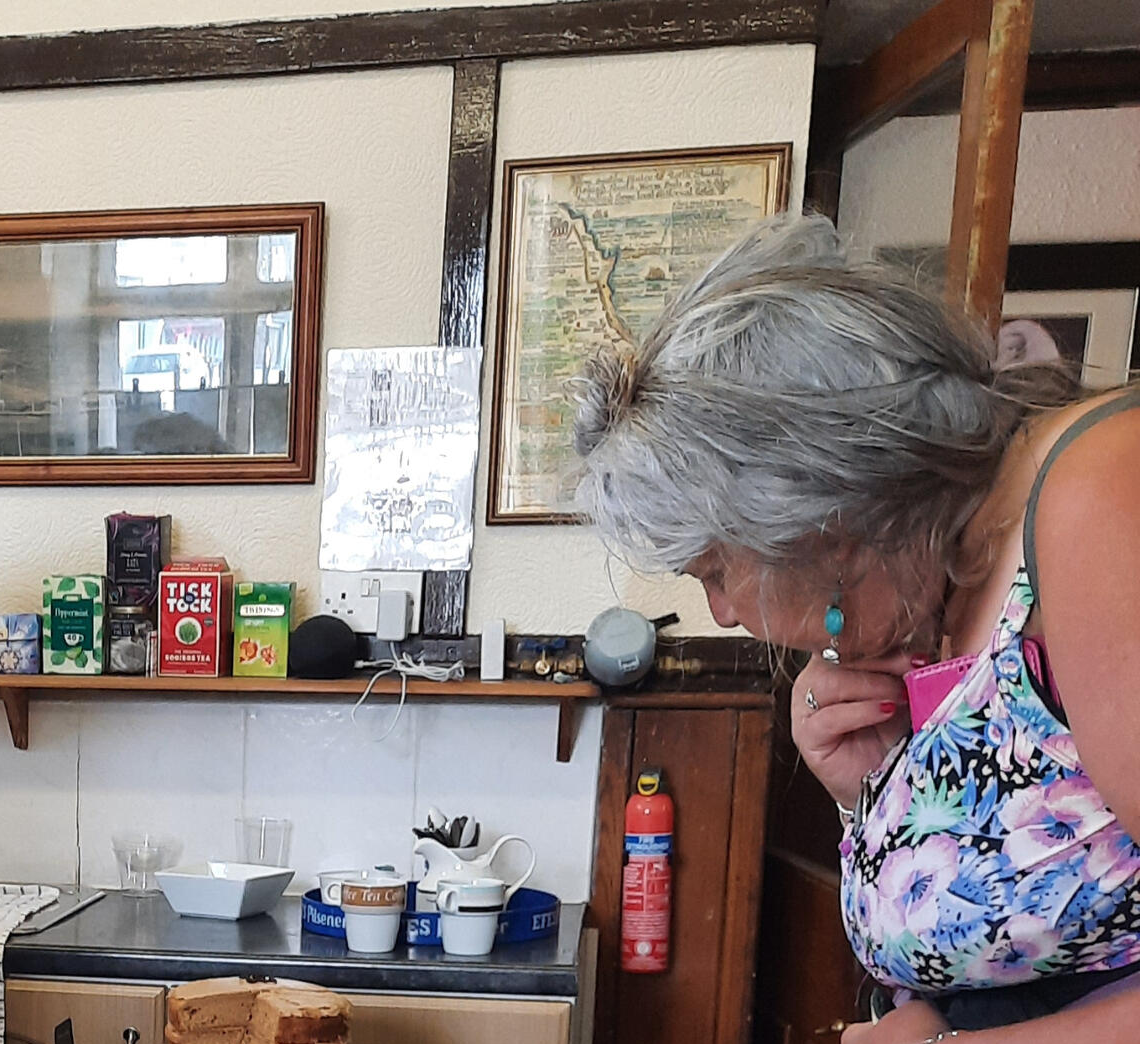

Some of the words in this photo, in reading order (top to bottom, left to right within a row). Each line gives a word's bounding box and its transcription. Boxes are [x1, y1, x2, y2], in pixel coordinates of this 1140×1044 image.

[166, 582, 212, 598] TICK
[166, 598, 212, 613] TOCK
[362, 887, 381, 902] Tea
